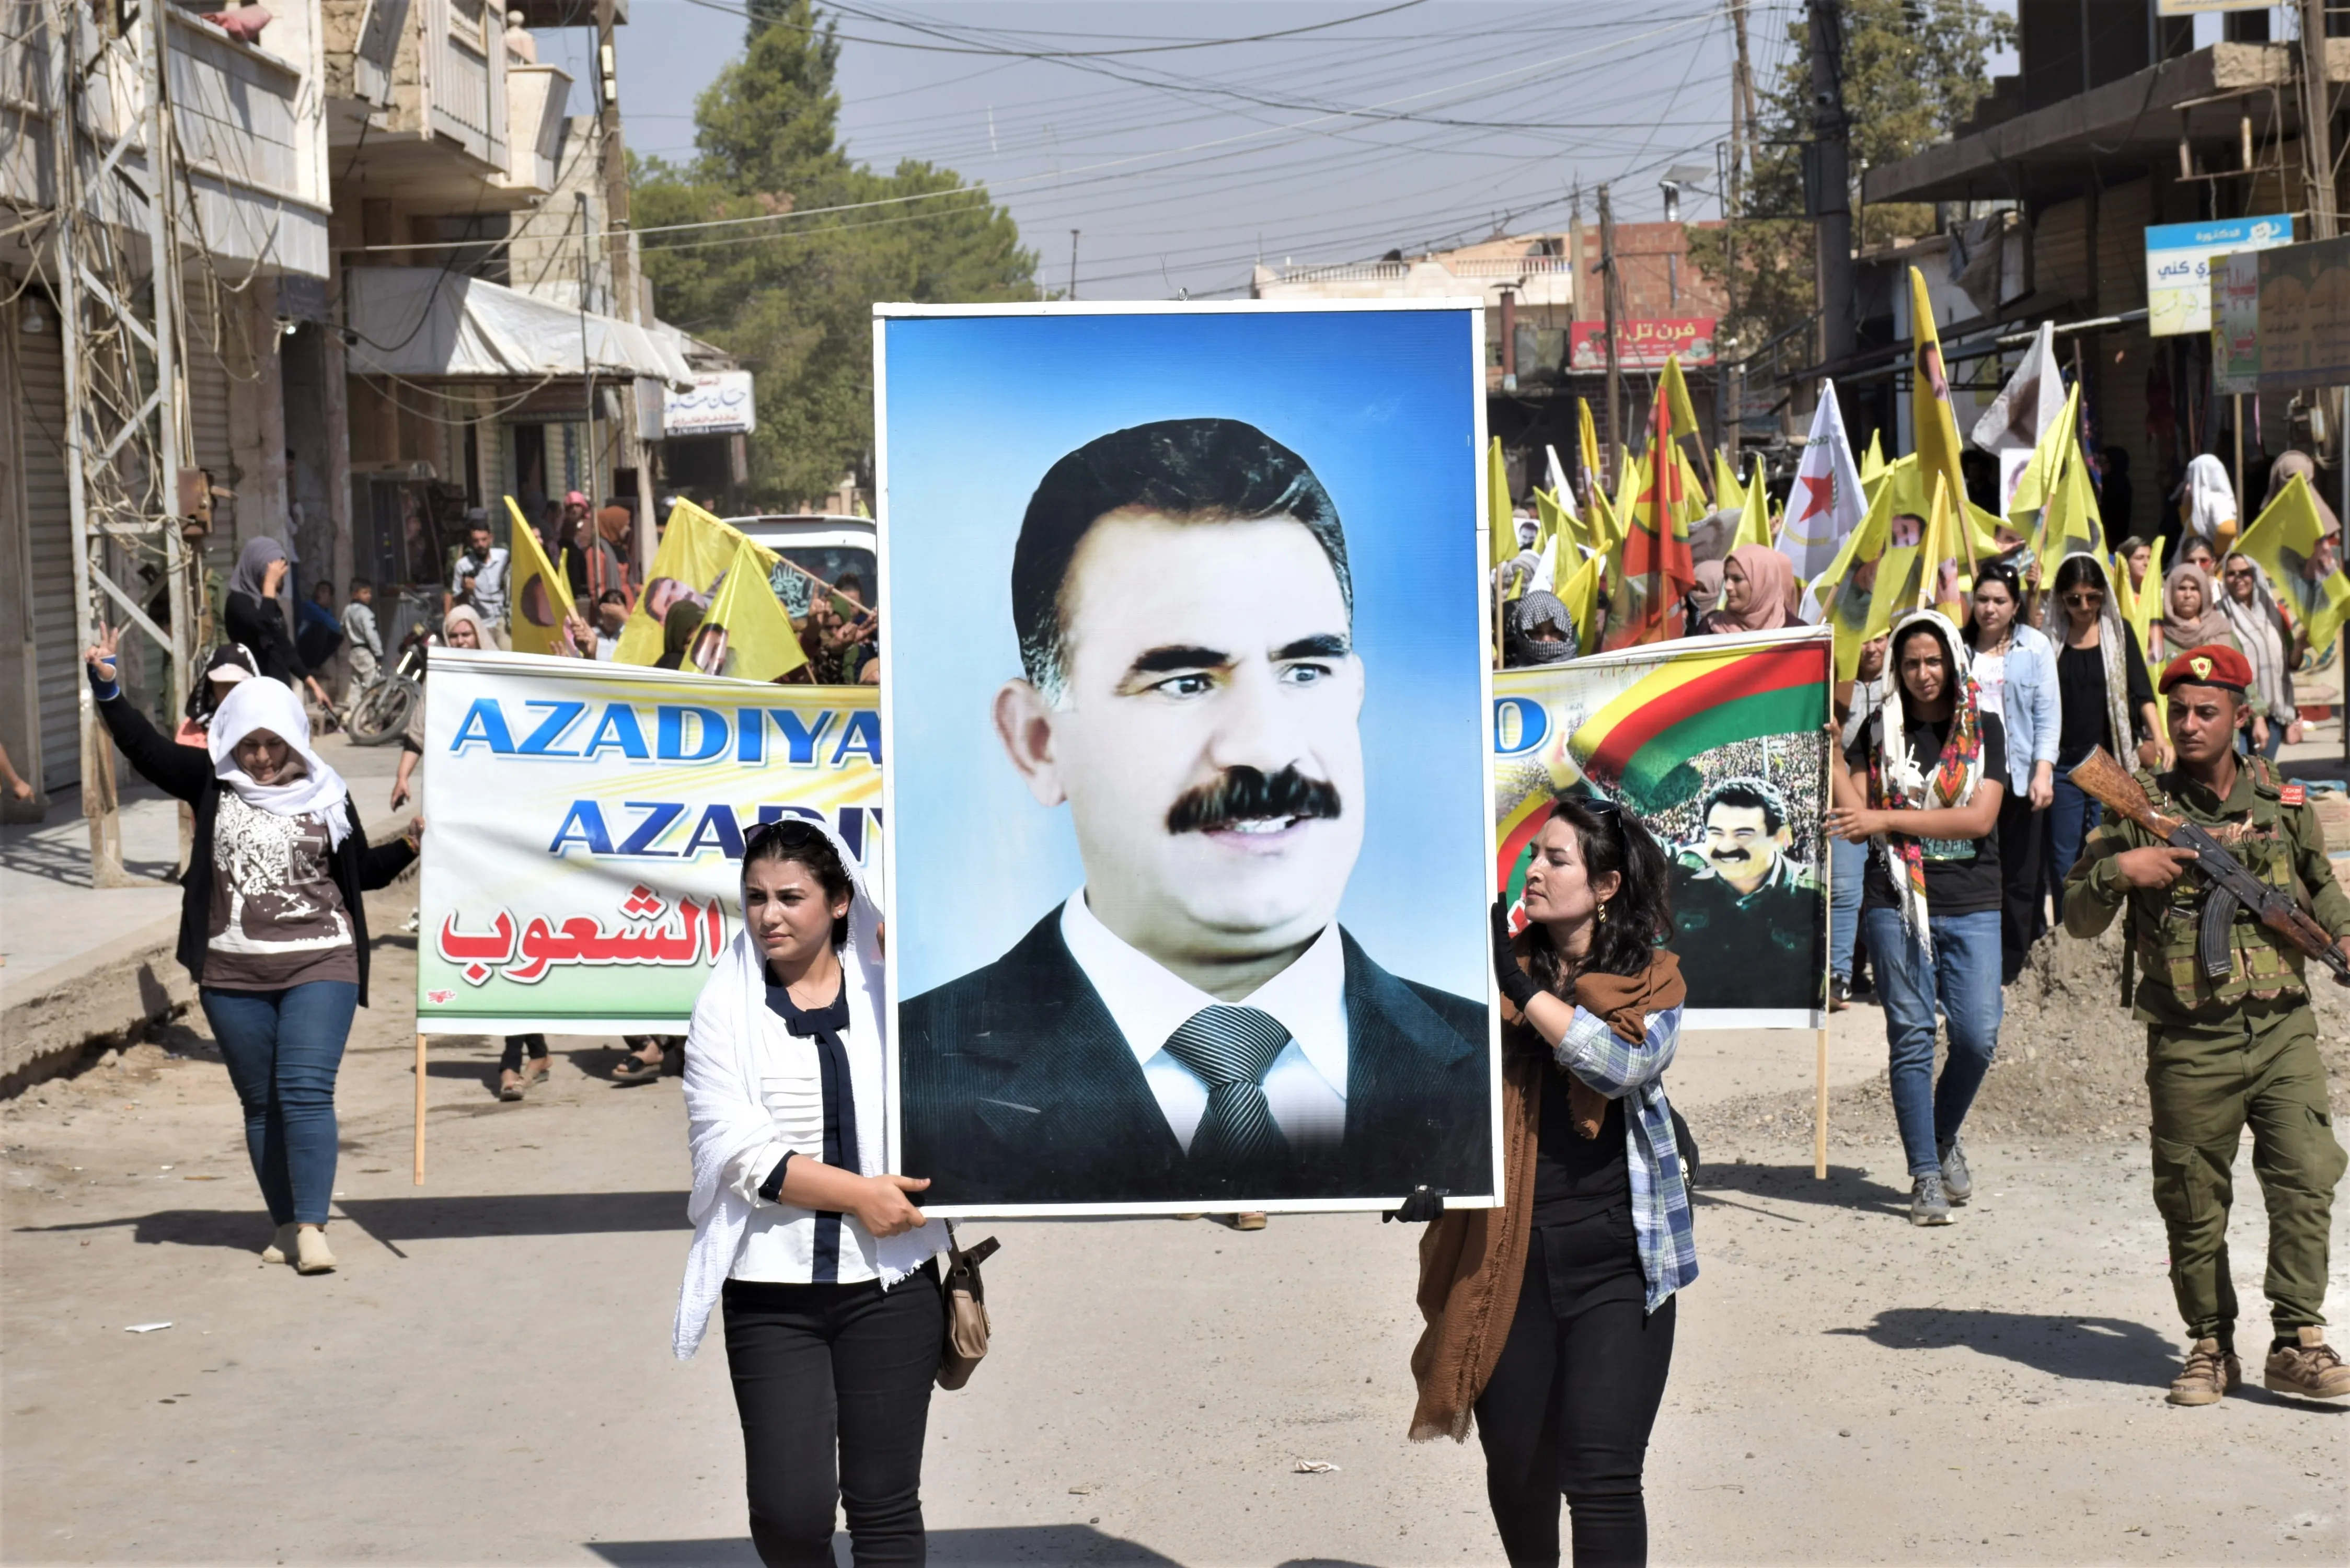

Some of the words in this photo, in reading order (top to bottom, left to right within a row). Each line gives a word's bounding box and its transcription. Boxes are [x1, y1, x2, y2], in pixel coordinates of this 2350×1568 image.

[1626, 323, 1653, 342] تل
[1656, 322, 1696, 340] فرن
[450, 697, 881, 765] AZADIYA
[548, 800, 882, 862] AZAI
[441, 884, 721, 979] الشعوب
